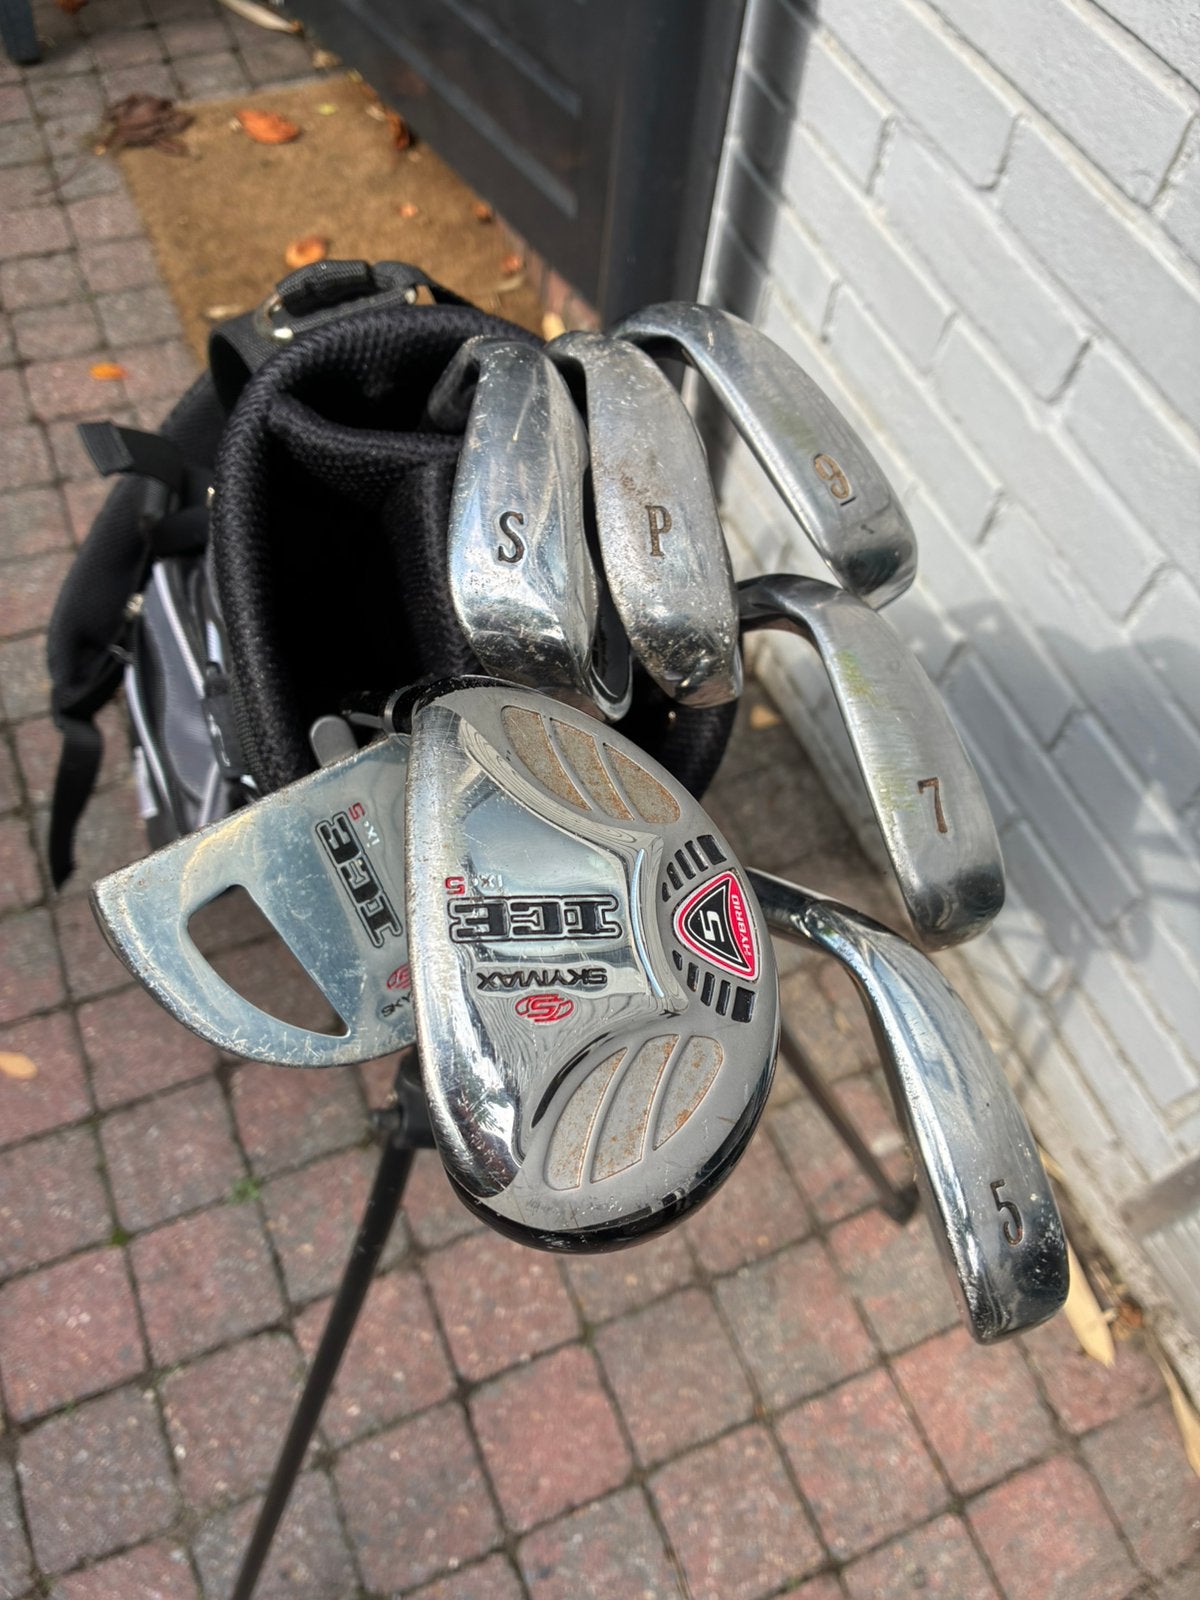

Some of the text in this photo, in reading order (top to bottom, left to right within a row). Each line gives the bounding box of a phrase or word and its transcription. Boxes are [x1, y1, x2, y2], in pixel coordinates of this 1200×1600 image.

[814, 453, 852, 501] 9
[497, 511, 526, 563] S
[645, 505, 672, 557] P
[917, 777, 948, 833] 7
[316, 812, 403, 948] ICE
[449, 896, 622, 943] ICE
[699, 909, 725, 943] 5
[731, 894, 752, 956] HYBRID
[381, 991, 411, 1017] SKY
[476, 967, 608, 991] SKYMAX
[990, 1178, 1023, 1246] 5
